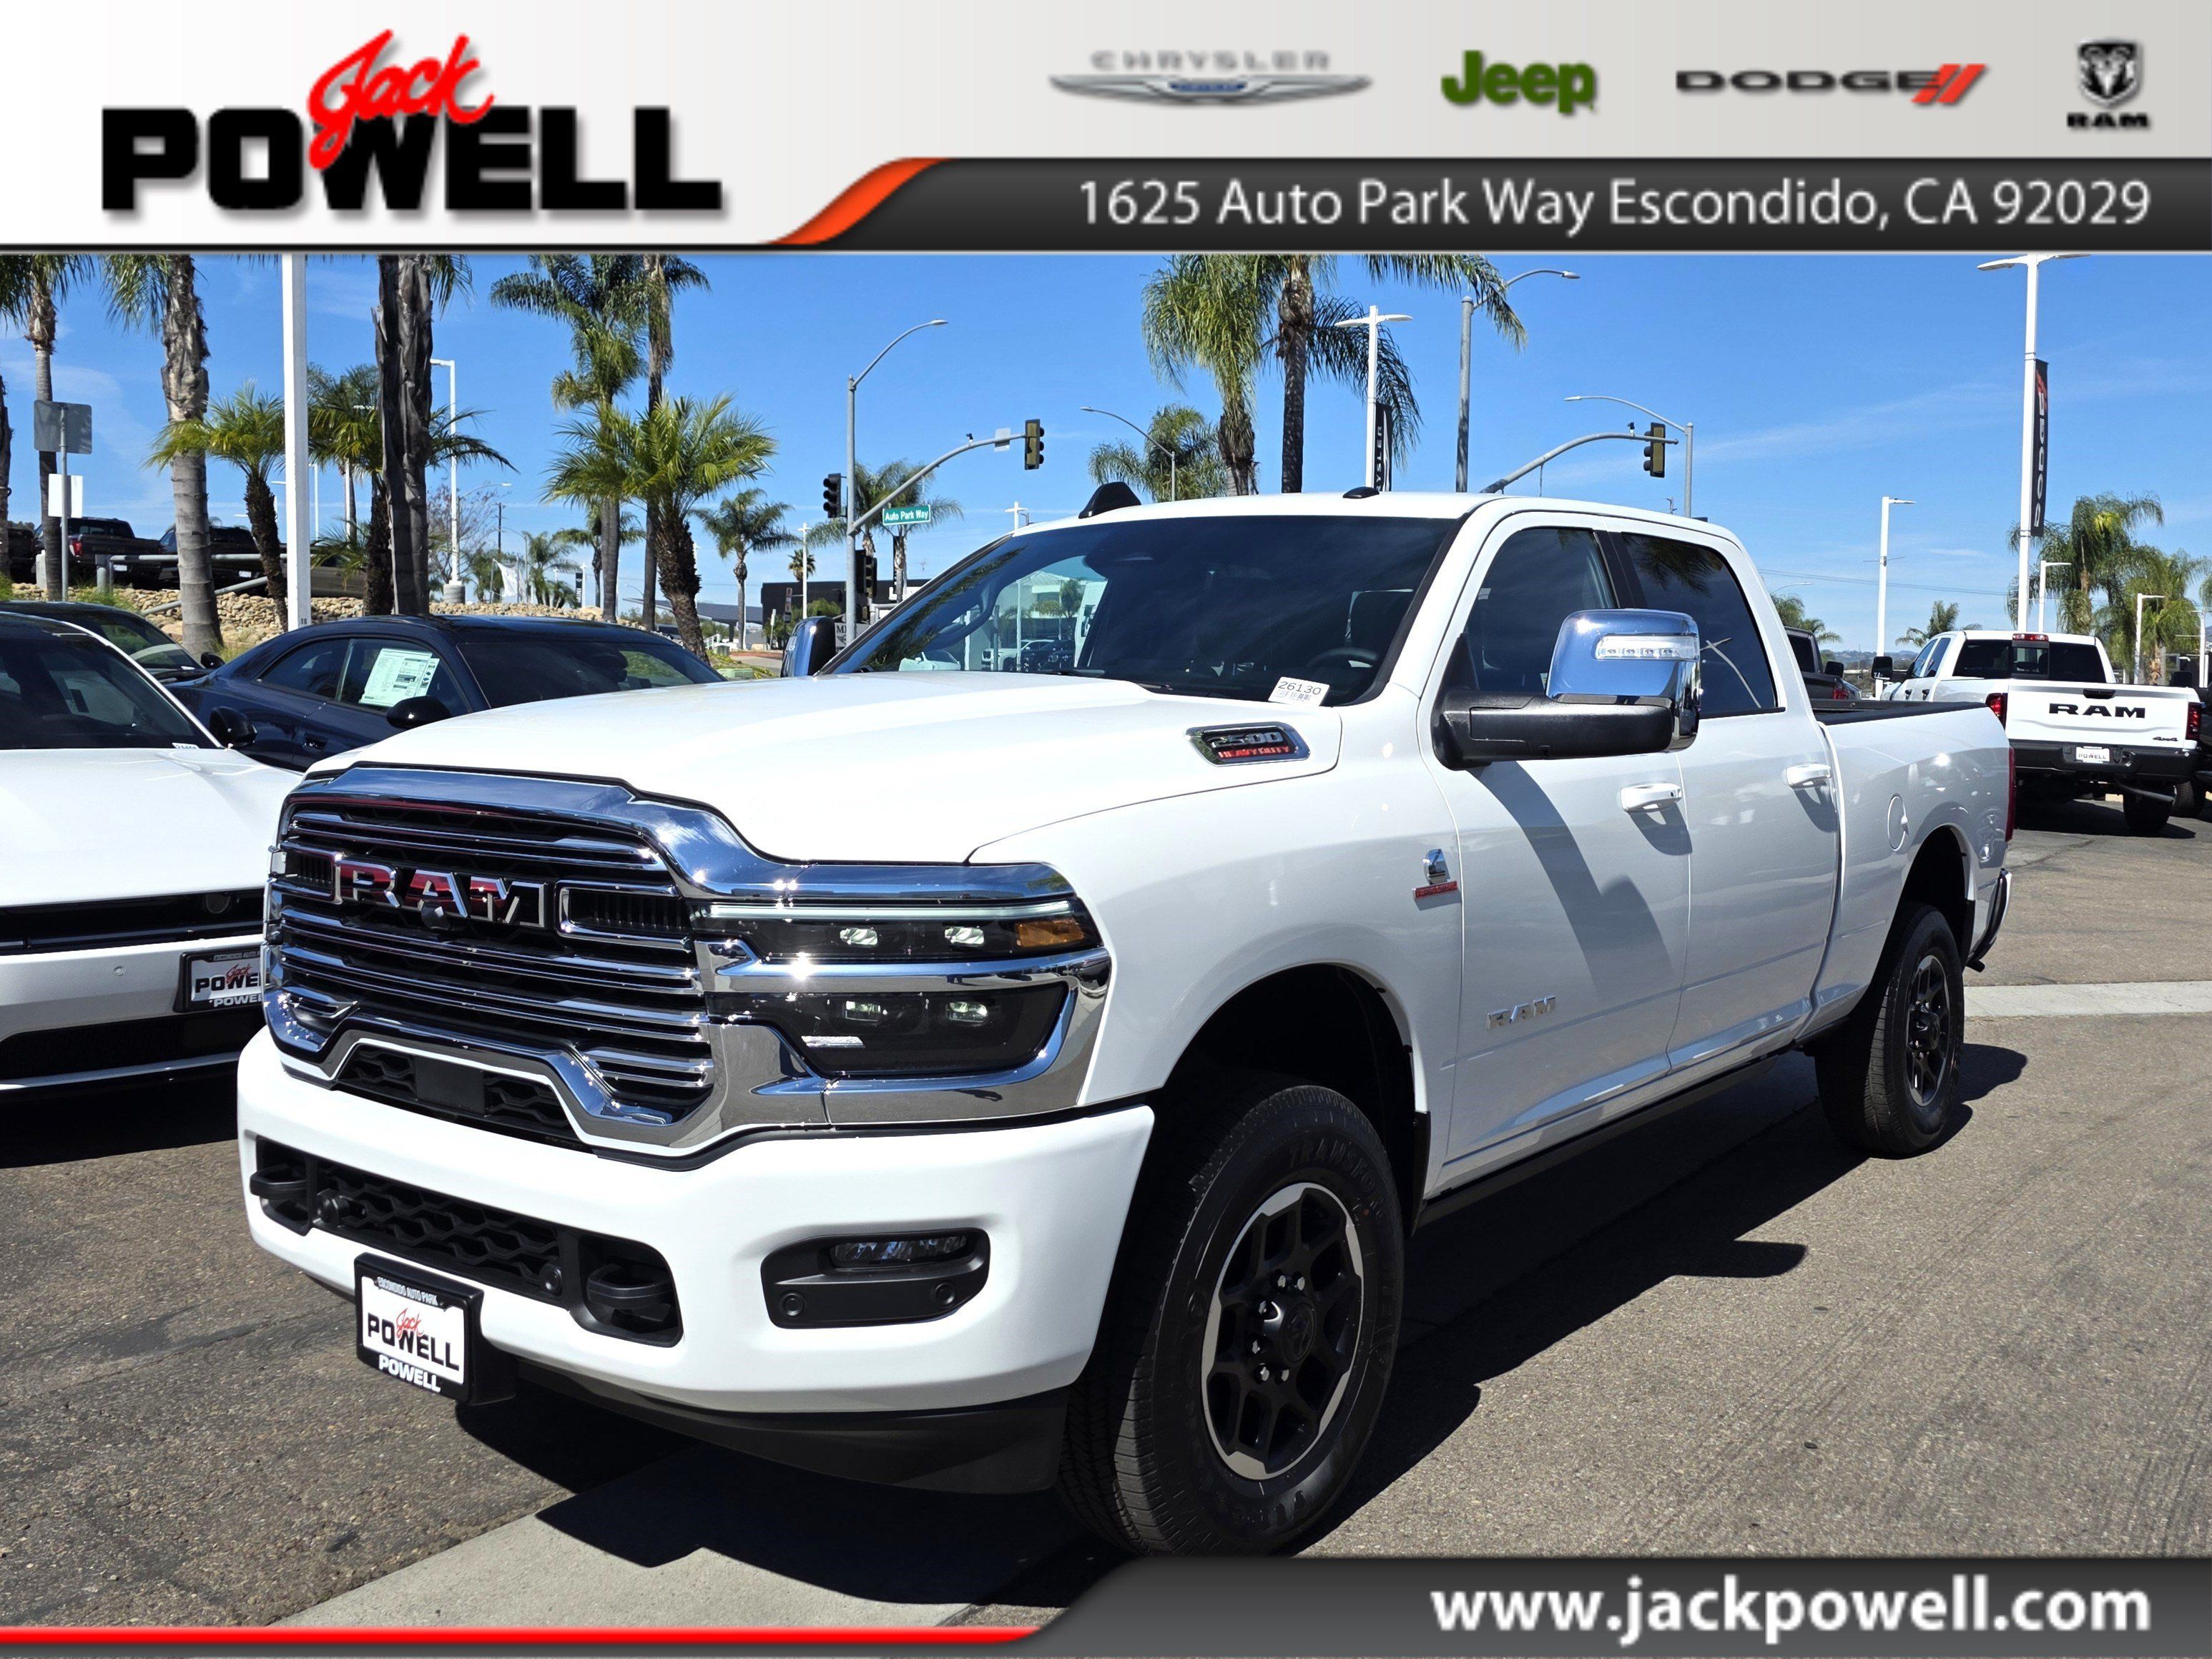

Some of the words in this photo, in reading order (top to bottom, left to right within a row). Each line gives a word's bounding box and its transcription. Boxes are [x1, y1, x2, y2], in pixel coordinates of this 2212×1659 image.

[885, 512, 899, 521] Auto
[900, 511, 914, 520] Park
[915, 509, 928, 520] Way
[1277, 681, 1322, 695] 26130
[2049, 703, 2145, 719] RAM
[336, 858, 548, 928] RAM
[195, 973, 261, 994] POWE
[213, 993, 262, 1008] POWEL
[1485, 995, 1557, 1031] RAM
[396, 1307, 424, 1339] Jack
[368, 1312, 460, 1372] POWELL
[378, 1354, 441, 1393] POWELL
